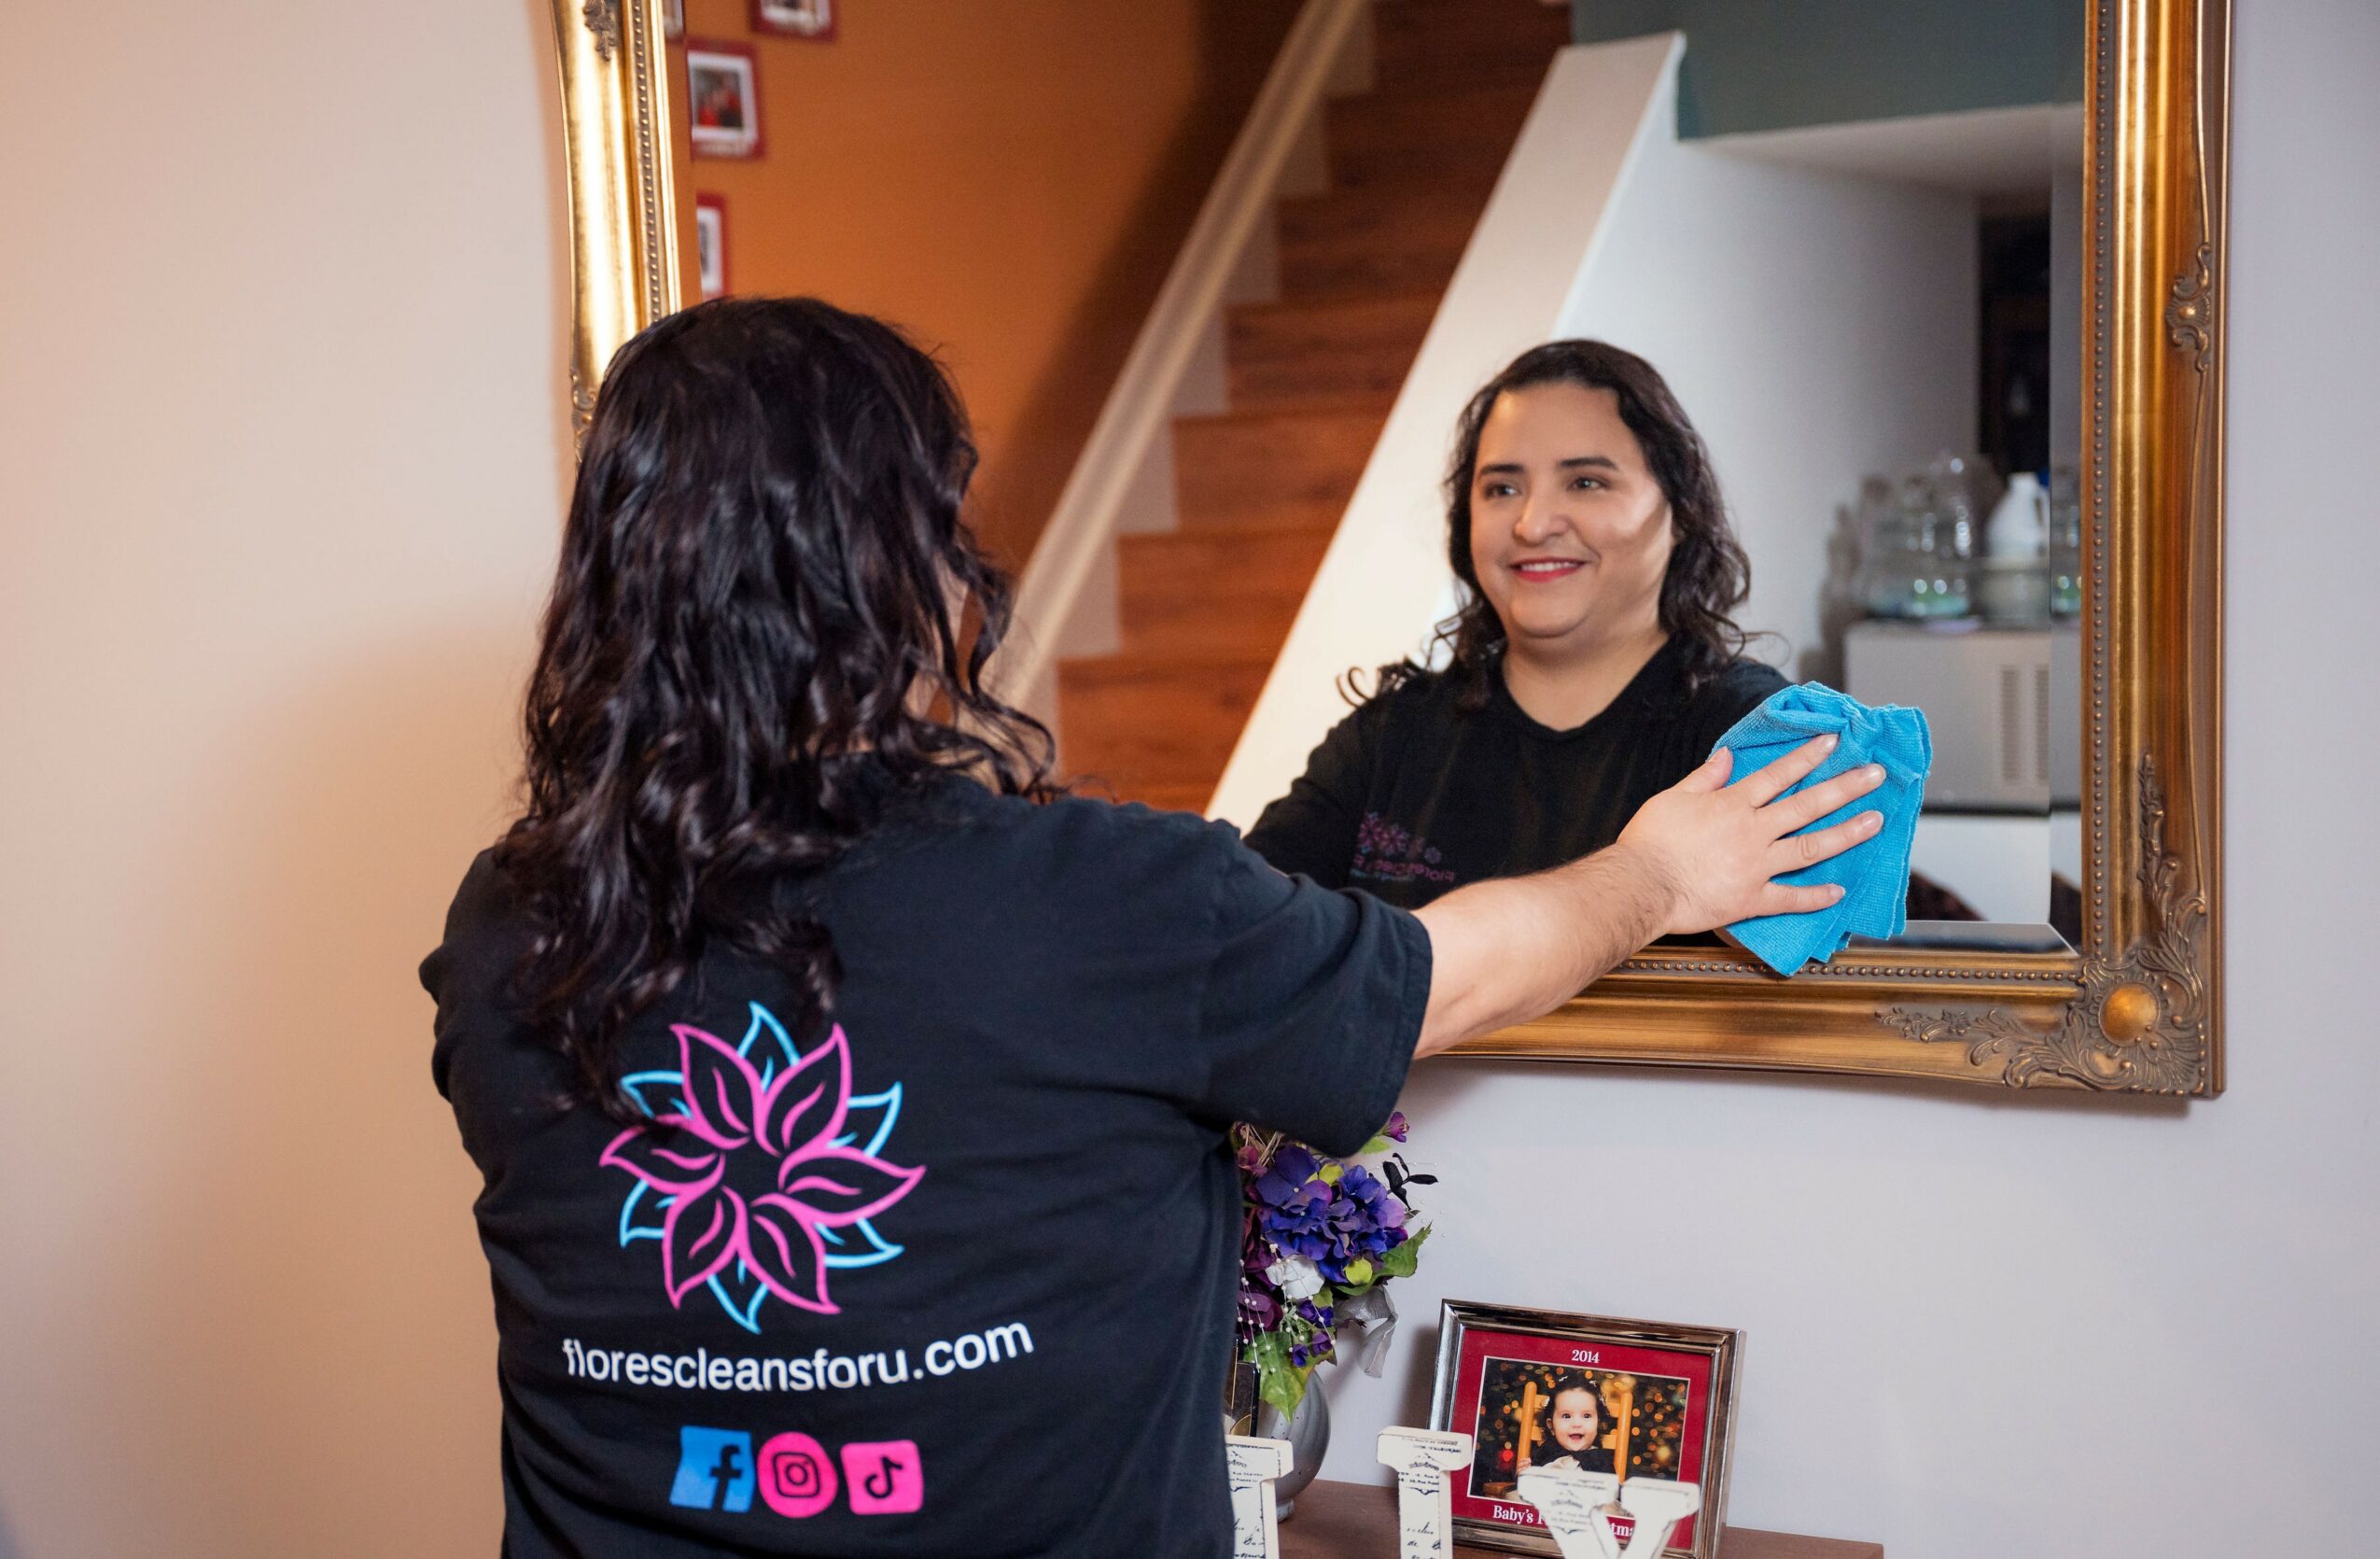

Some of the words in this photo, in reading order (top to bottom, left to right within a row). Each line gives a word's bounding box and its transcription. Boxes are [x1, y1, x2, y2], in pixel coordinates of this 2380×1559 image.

[562, 1322, 1034, 1391] florescleansforu.com
[1571, 1349, 1600, 1364] 2014
[1493, 1504, 1534, 1525] Baby's
